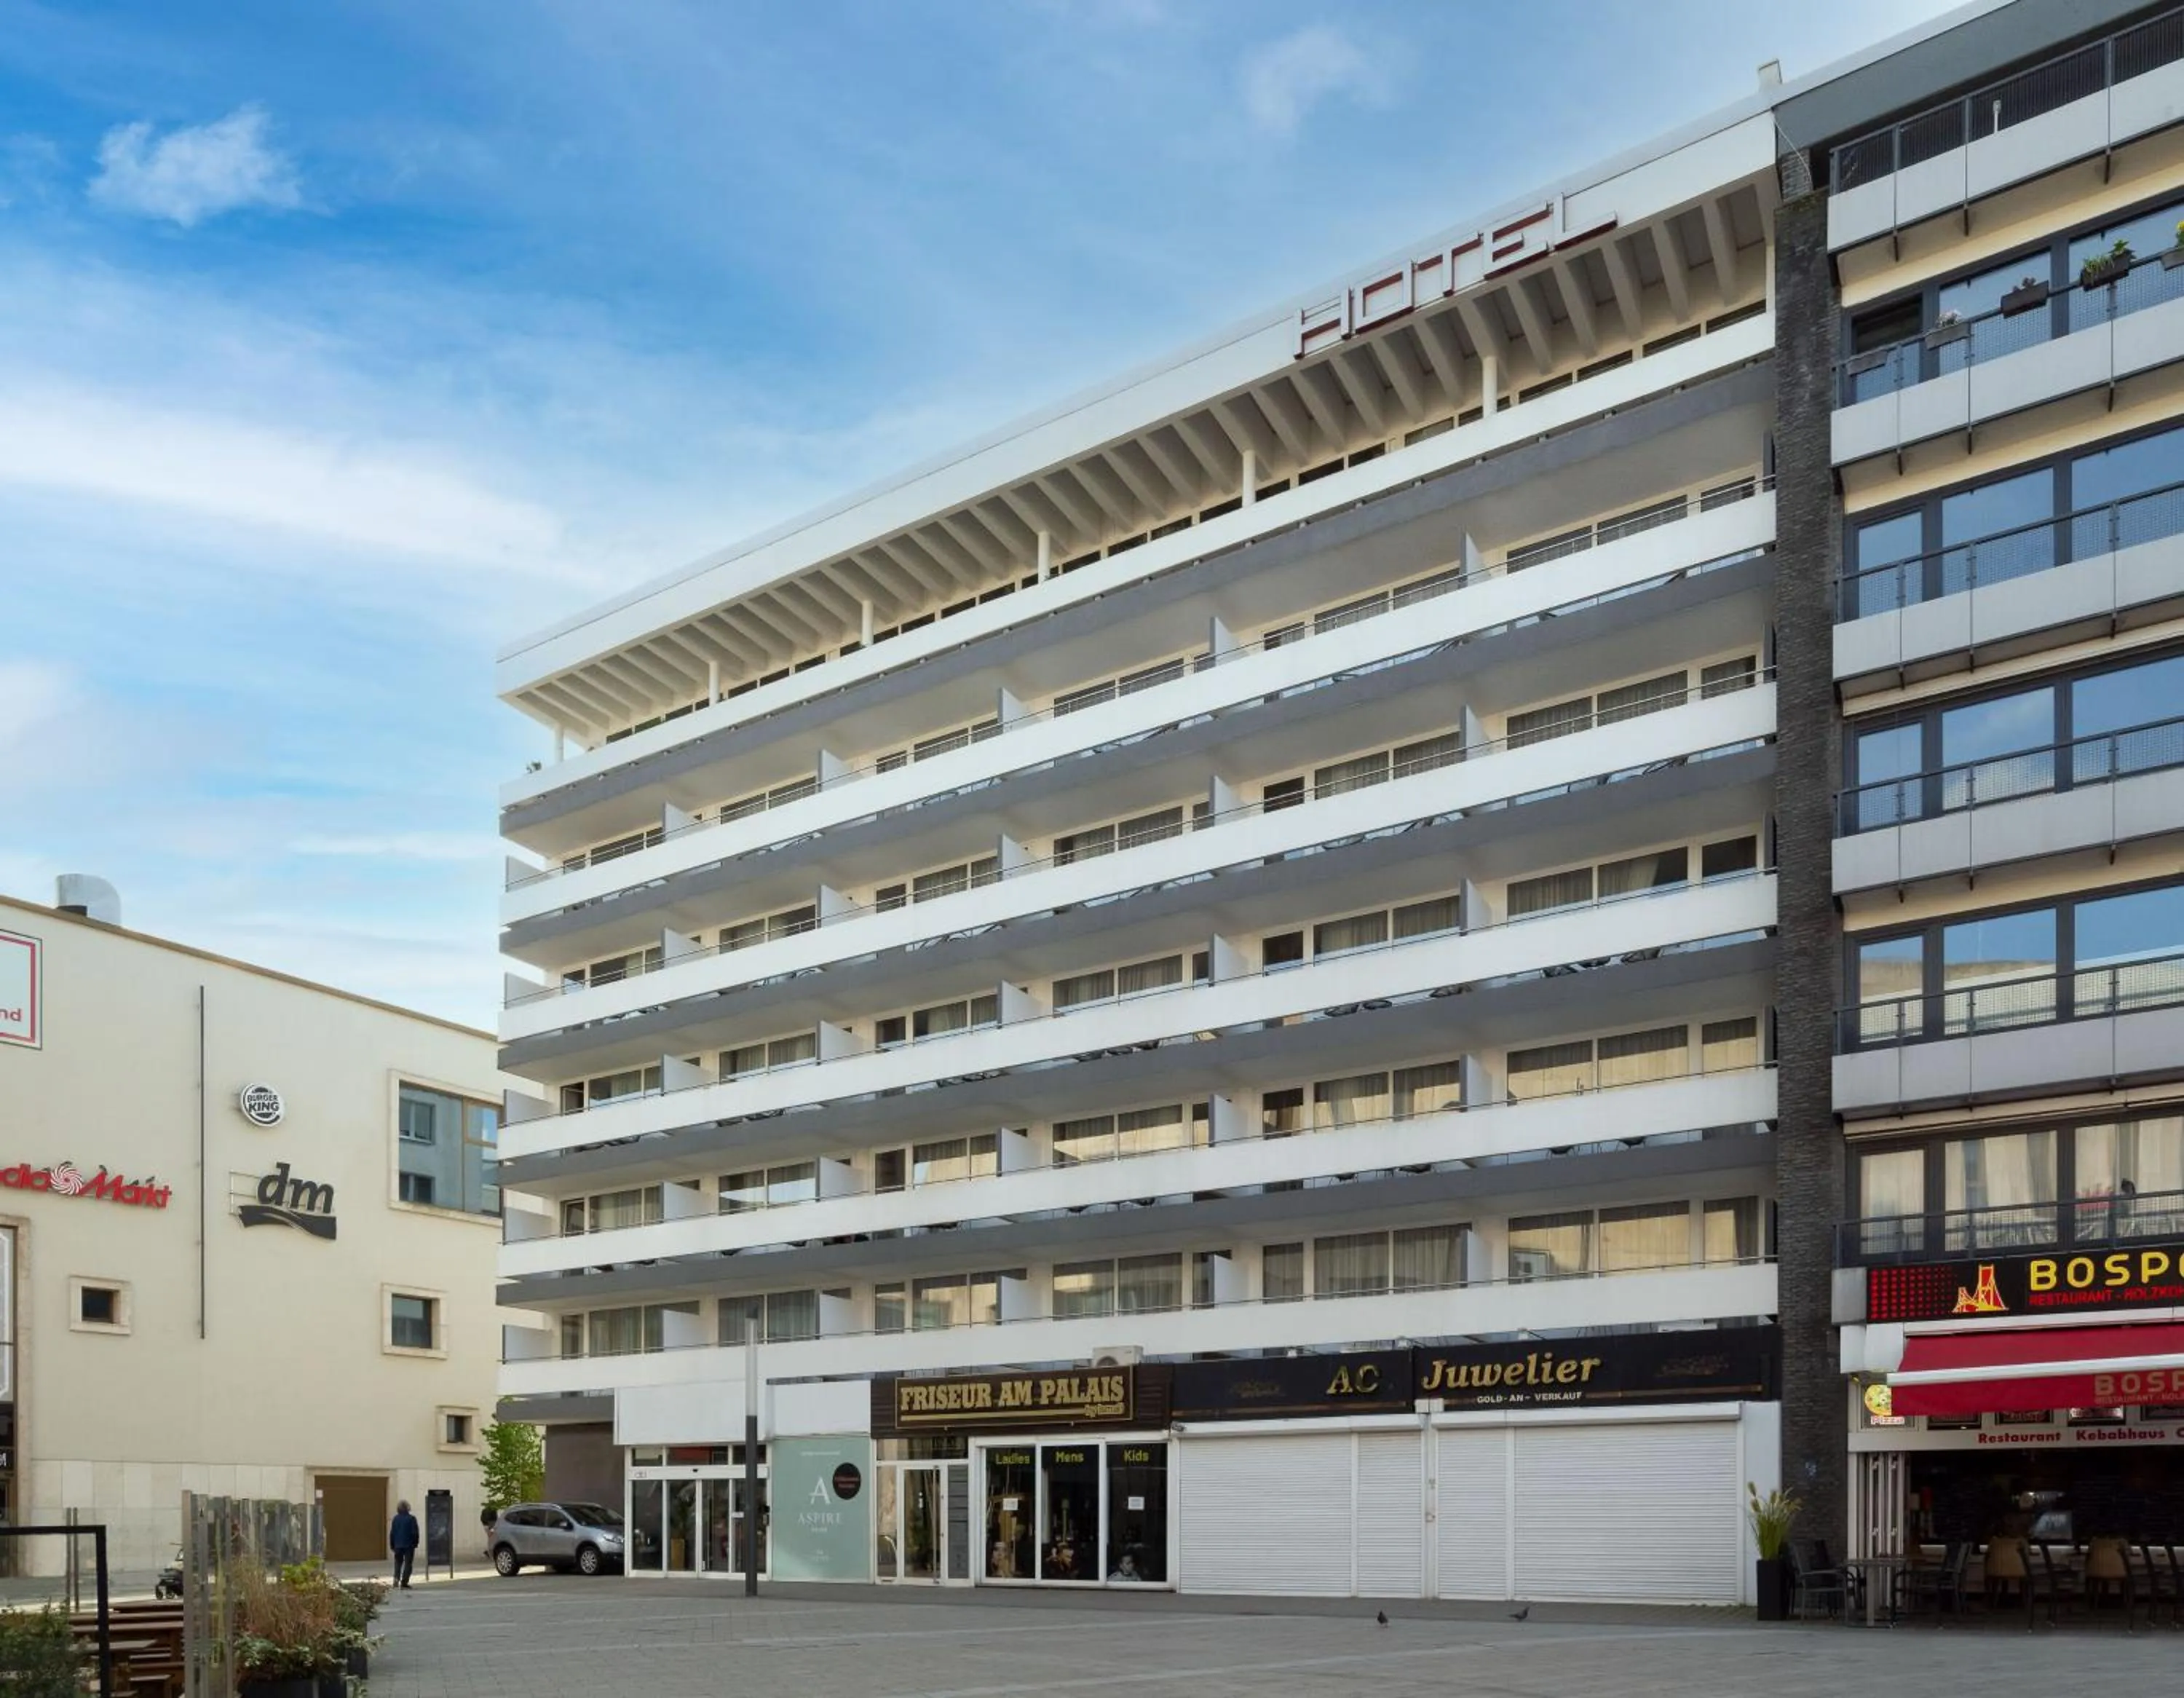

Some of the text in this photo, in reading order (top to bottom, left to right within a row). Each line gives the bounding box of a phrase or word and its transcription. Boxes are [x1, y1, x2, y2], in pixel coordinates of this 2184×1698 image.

[1293, 192, 1618, 360] HOTEL
[248, 1094, 279, 1102] BURGER
[248, 1102, 280, 1112] KING
[0, 1164, 173, 1209] dia Markt
[258, 1162, 334, 1214] dm
[2030, 1251, 2184, 1291] BOSP
[2029, 1290, 2113, 1306] RESTAURANT
[1326, 1364, 1380, 1394] AC
[1423, 1352, 1601, 1390] Juwelier
[901, 1376, 1124, 1410] FRISEUR AM PALAIS
[1534, 1391, 1583, 1402] VERKAUF
[1978, 1432, 2061, 1444] Restaurant
[2076, 1428, 2166, 1442] Kebabhaus
[995, 1453, 1030, 1465] Ladies
[1056, 1451, 1084, 1463] Mens
[1123, 1450, 1150, 1462] Kids
[808, 1476, 831, 1505] A
[798, 1512, 843, 1525] ASPIRE
